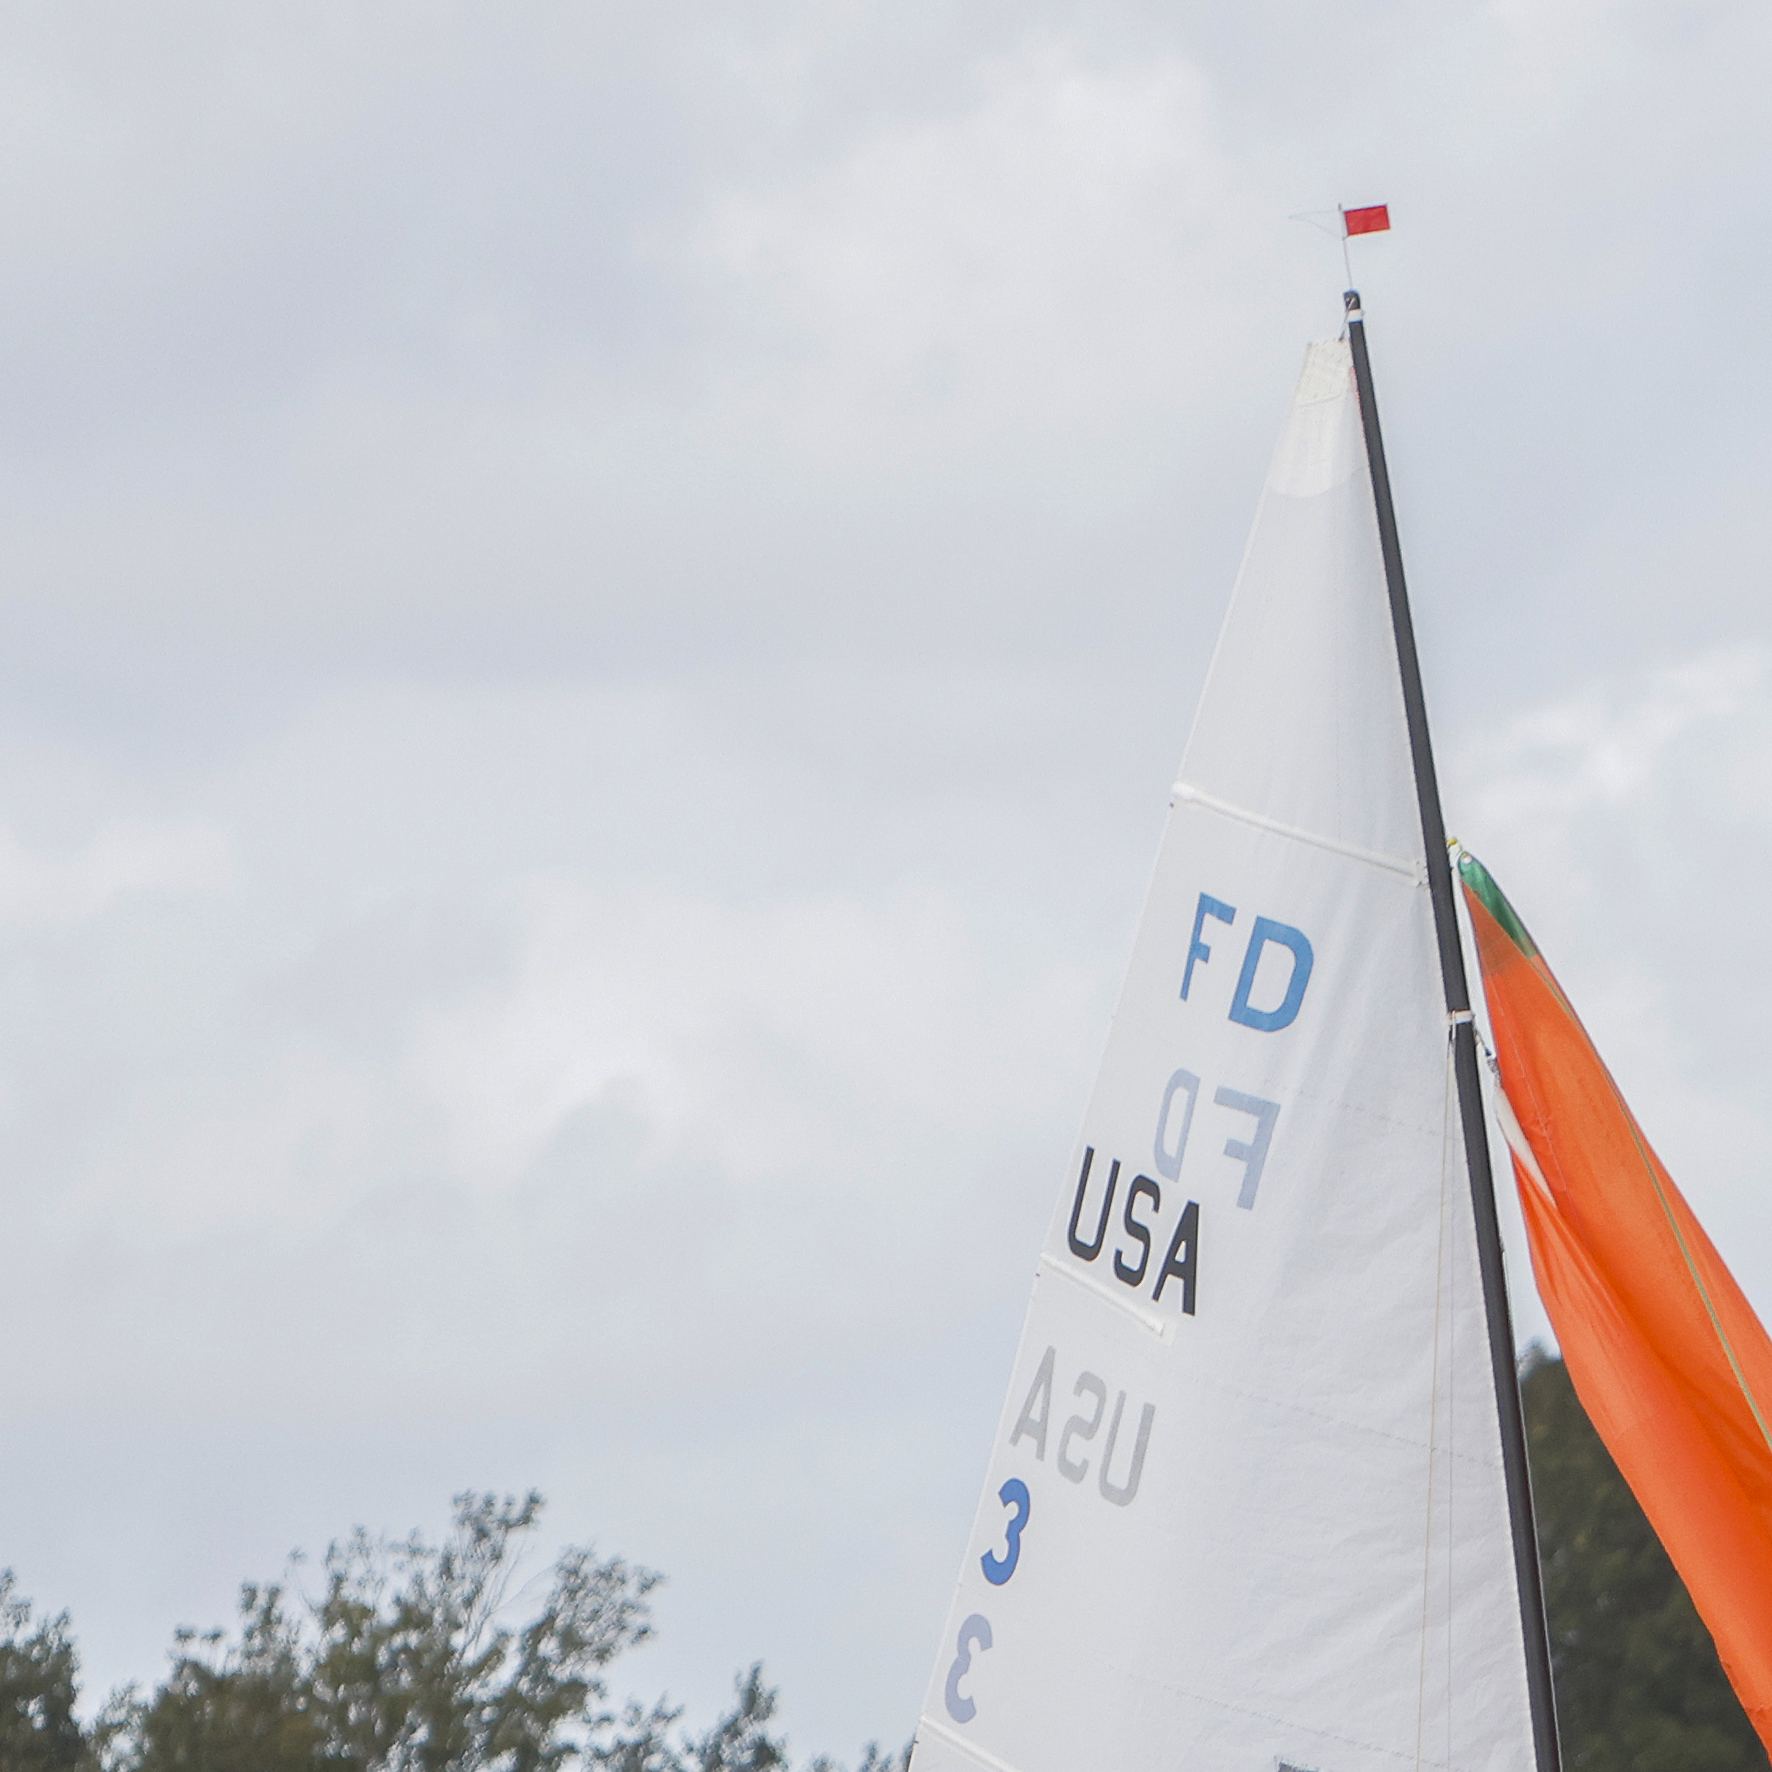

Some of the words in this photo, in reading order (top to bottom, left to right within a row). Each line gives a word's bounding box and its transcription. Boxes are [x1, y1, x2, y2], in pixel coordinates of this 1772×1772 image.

[1180, 892, 1314, 1032] FD
[1067, 1147, 1200, 1316] USA
[980, 1477, 1030, 1586] 3
